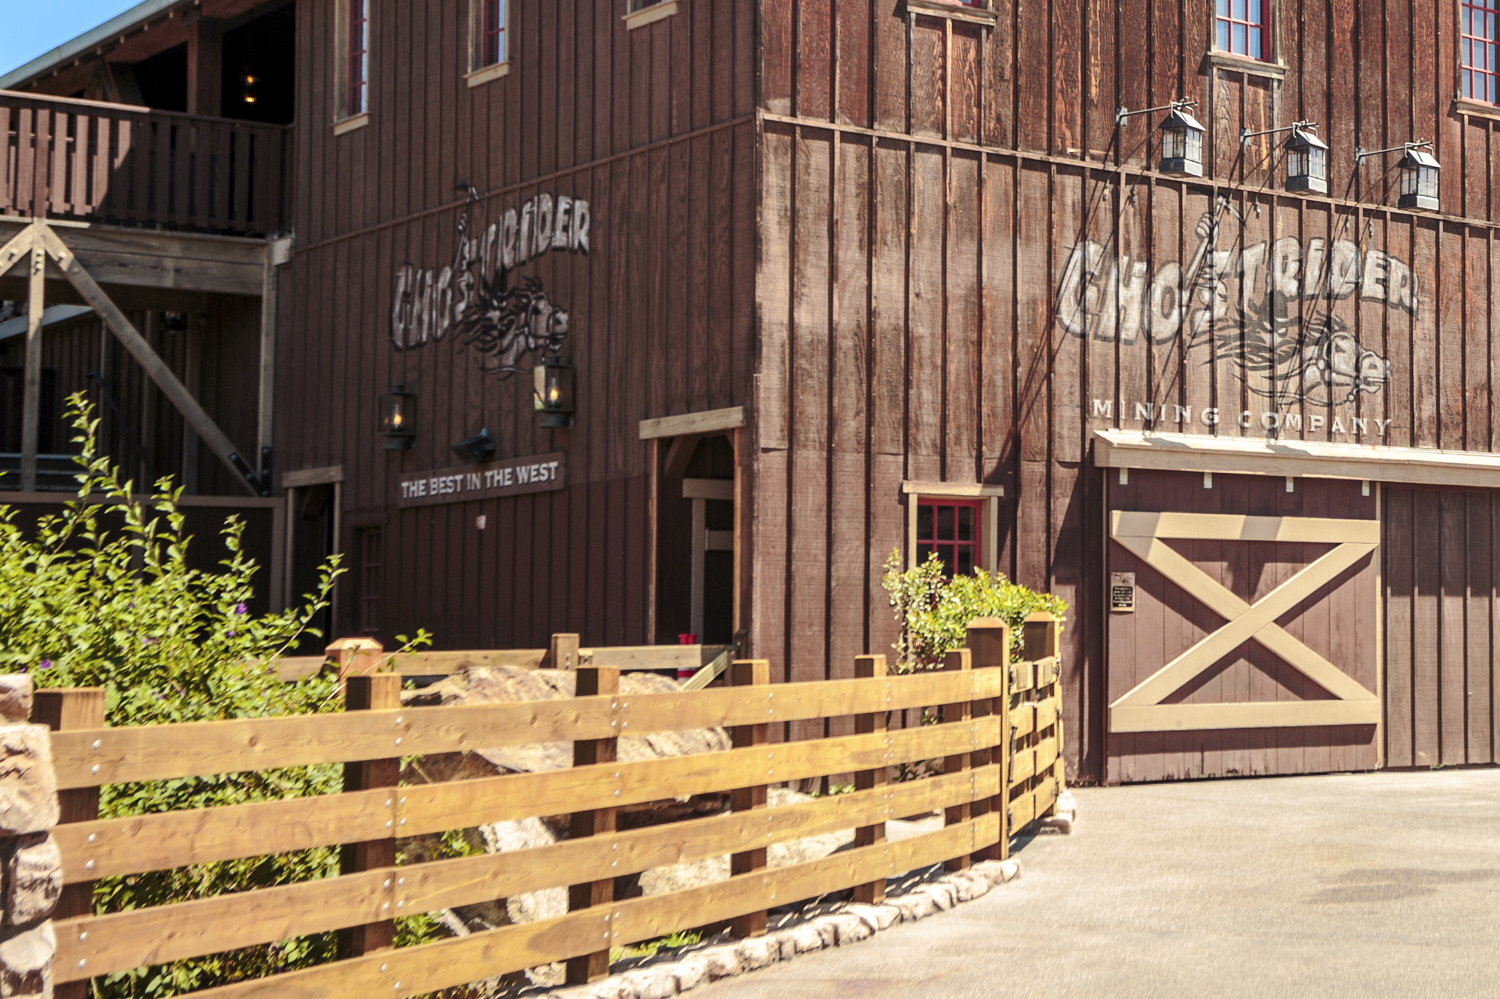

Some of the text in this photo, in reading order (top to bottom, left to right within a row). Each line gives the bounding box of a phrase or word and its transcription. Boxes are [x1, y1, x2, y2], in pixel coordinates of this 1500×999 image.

[1055, 235, 1420, 345] GHOSTRIDER
[1092, 398, 1392, 436] MINING COMPANY
[401, 461, 559, 499] THE BEST IN THE WEST
